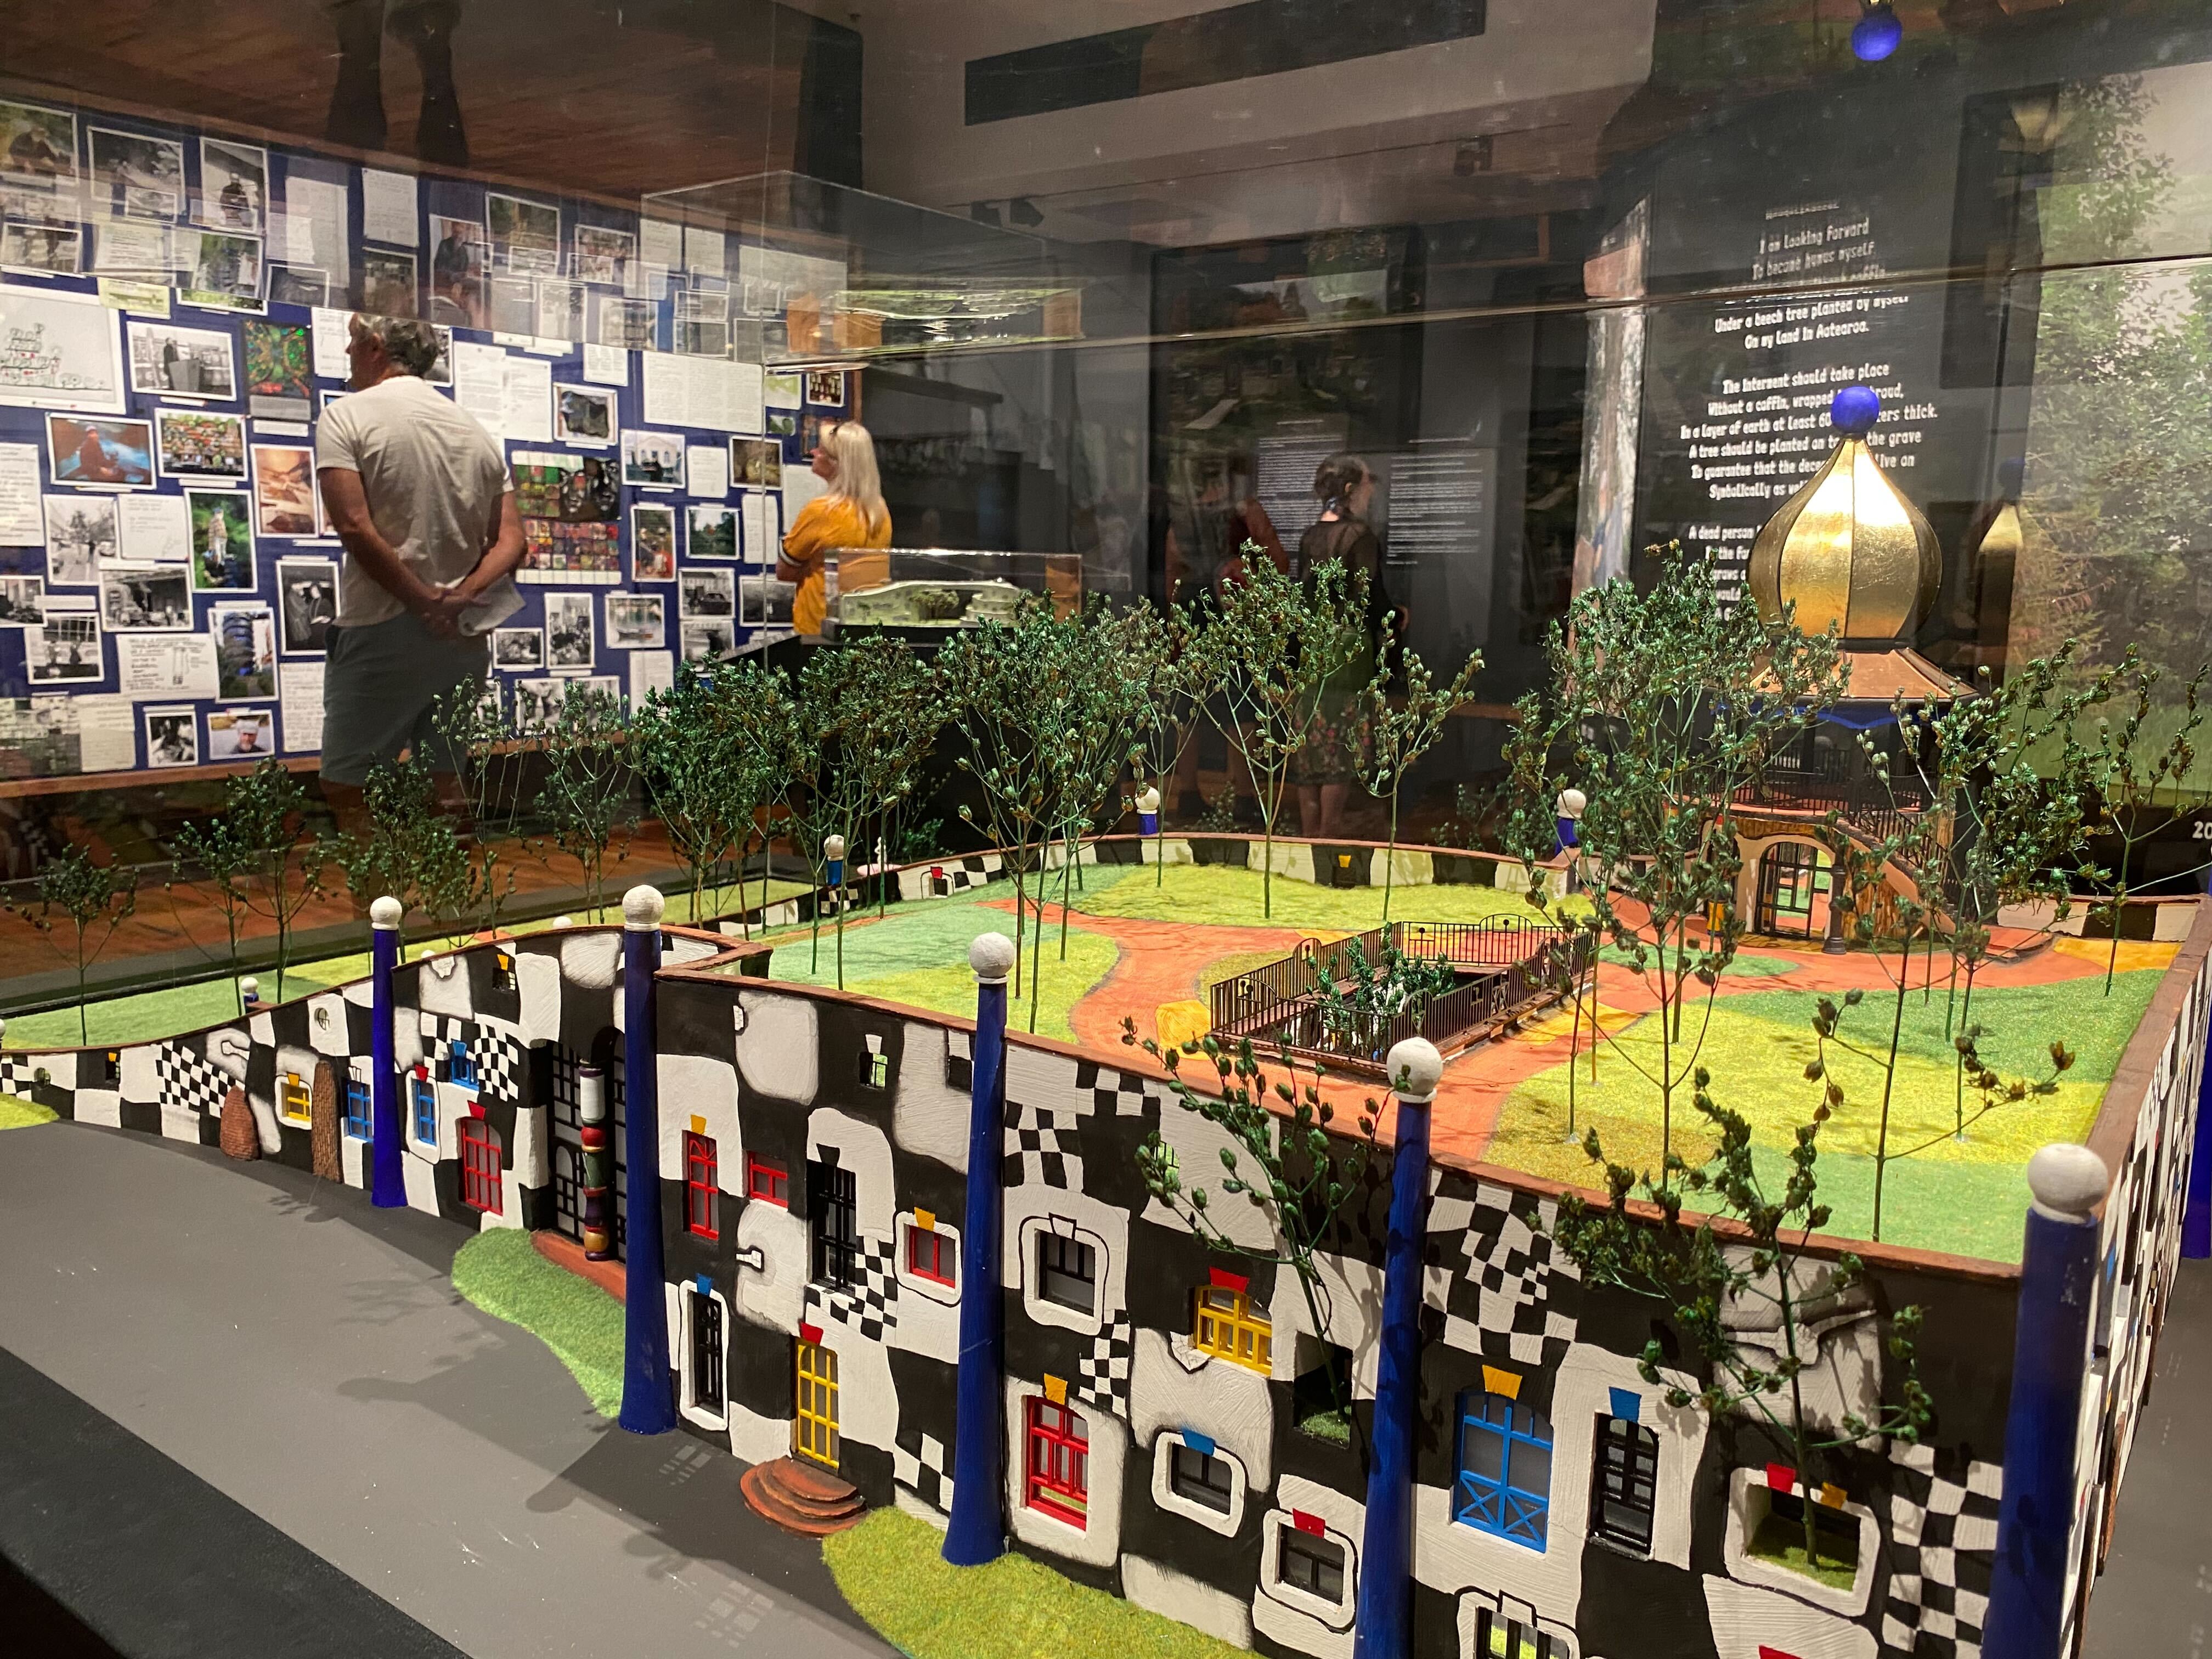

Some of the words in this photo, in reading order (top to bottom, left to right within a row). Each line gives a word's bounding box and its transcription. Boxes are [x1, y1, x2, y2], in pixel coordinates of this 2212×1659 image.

[1826, 217, 1869, 241] forward
[1752, 263, 1764, 281] To
[1714, 315, 1743, 333] Under
[1745, 317, 1752, 328] a
[1755, 309, 1783, 328] beech
[1785, 306, 1808, 321] tree
[1811, 300, 1853, 320] planted
[1745, 335, 1759, 349] On
[1760, 335, 1774, 348] my
[1776, 329, 1799, 345] land
[1816, 320, 1869, 338] Aotearoa.
[1722, 380, 1740, 394] The
[1792, 368, 1827, 386] should
[1830, 366, 1855, 382] take
[1858, 363, 1889, 381] place
[1708, 399, 1745, 416] Without
[1746, 401, 1754, 413] a
[1756, 396, 1790, 412] coffin,
[1792, 390, 1834, 409] wrapped
[1680, 425, 1691, 440] In
[1692, 427, 1700, 438] a
[1701, 424, 1727, 439] layer
[1729, 419, 1742, 436] of
[1742, 418, 1771, 434] earth
[1773, 417, 1787, 432] at
[1787, 414, 1817, 431] least
[1818, 412, 1832, 427] 60
[1904, 403, 1938, 420] thick.
[1689, 444, 1697, 459] A
[1699, 444, 1719, 458] tree
[1720, 440, 1753, 456] should
[1755, 439, 1767, 454] be
[1769, 436, 1809, 455] planted
[1812, 438, 1825, 450] on
[1828, 435, 1841, 449] to
[1866, 431, 1885, 446] the
[1889, 431, 1922, 448] grave
[1691, 464, 1703, 479] To
[1705, 462, 1752, 481] guarantee
[1754, 460, 1776, 476] that
[1779, 459, 1795, 474] the
[1900, 455, 1915, 467] on
[1708, 481, 1770, 500] Symbolically
[1773, 484, 1786, 495] as
[1689, 525, 1697, 539] A
[1699, 525, 1720, 539] dead
[1722, 528, 1754, 541] person
[1719, 546, 1734, 560] the
